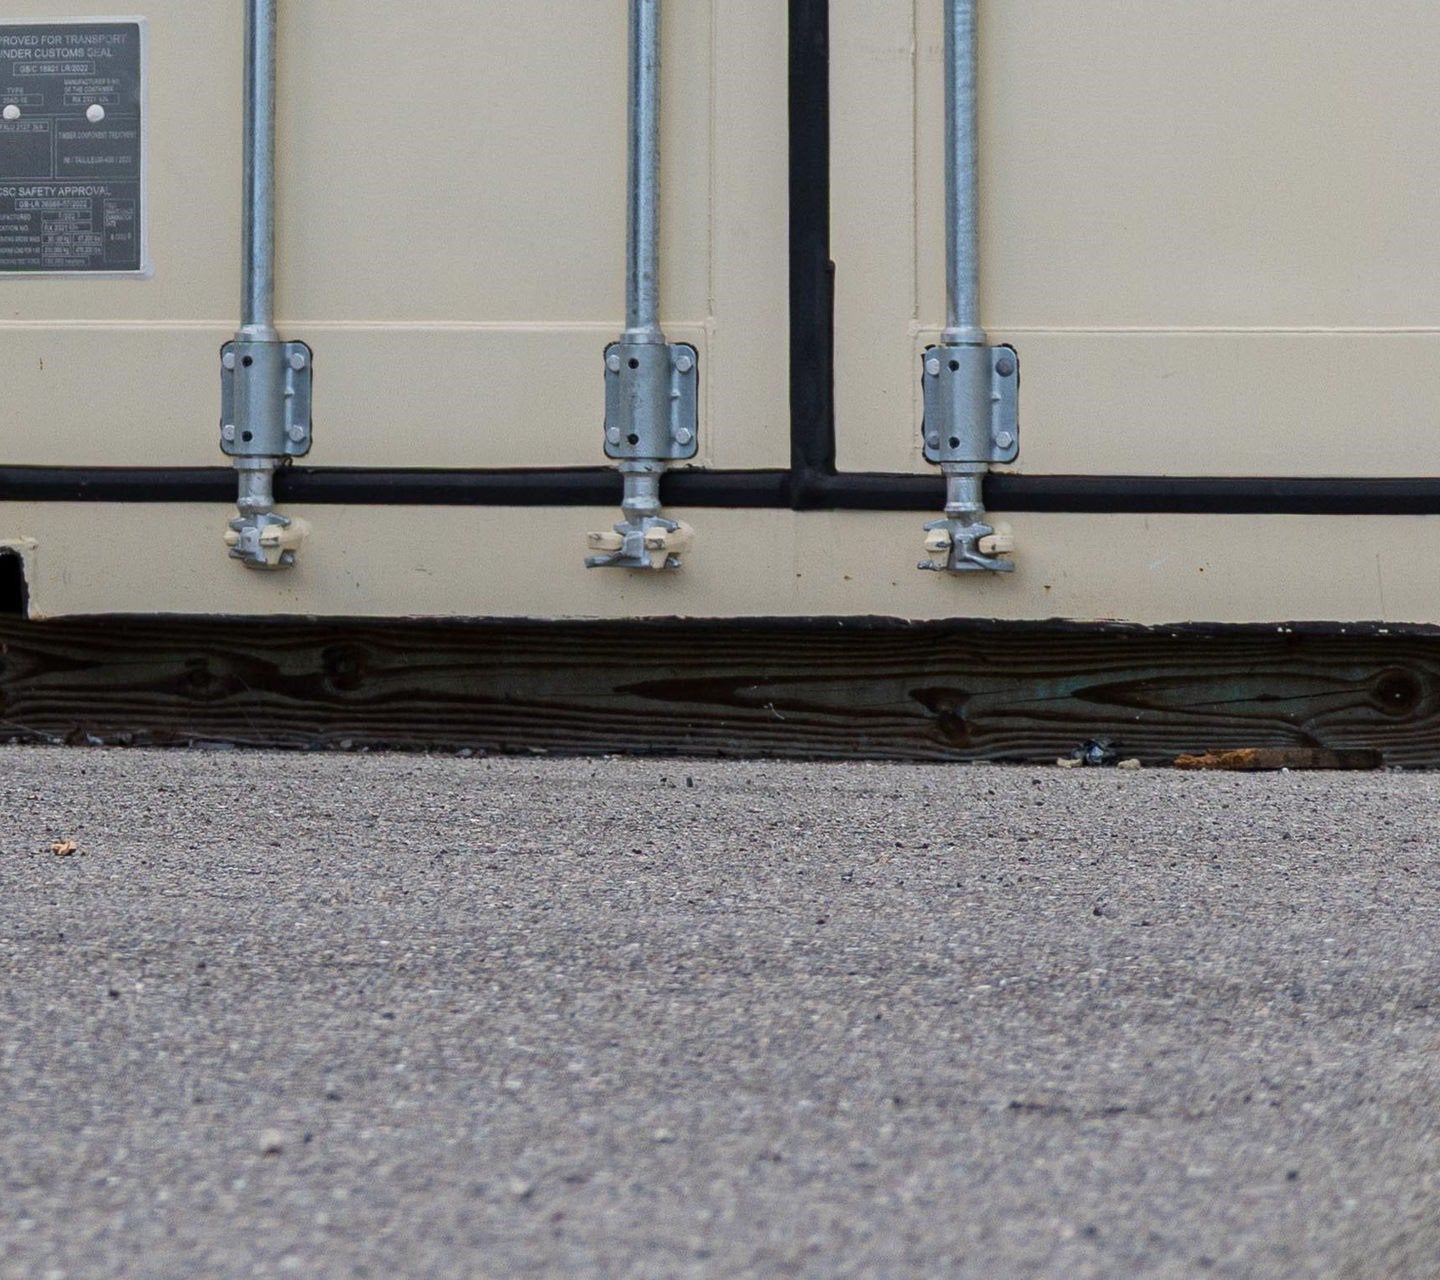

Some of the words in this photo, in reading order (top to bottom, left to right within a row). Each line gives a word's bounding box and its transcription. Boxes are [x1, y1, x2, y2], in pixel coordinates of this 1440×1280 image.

[41, 35, 62, 45] FOR
[66, 34, 127, 45] TRANSPORT
[34, 47, 85, 58] CUSTOMS
[87, 47, 113, 58] SEAL
[19, 187, 57, 197] SAFETY
[58, 186, 111, 196] APPROVAL
